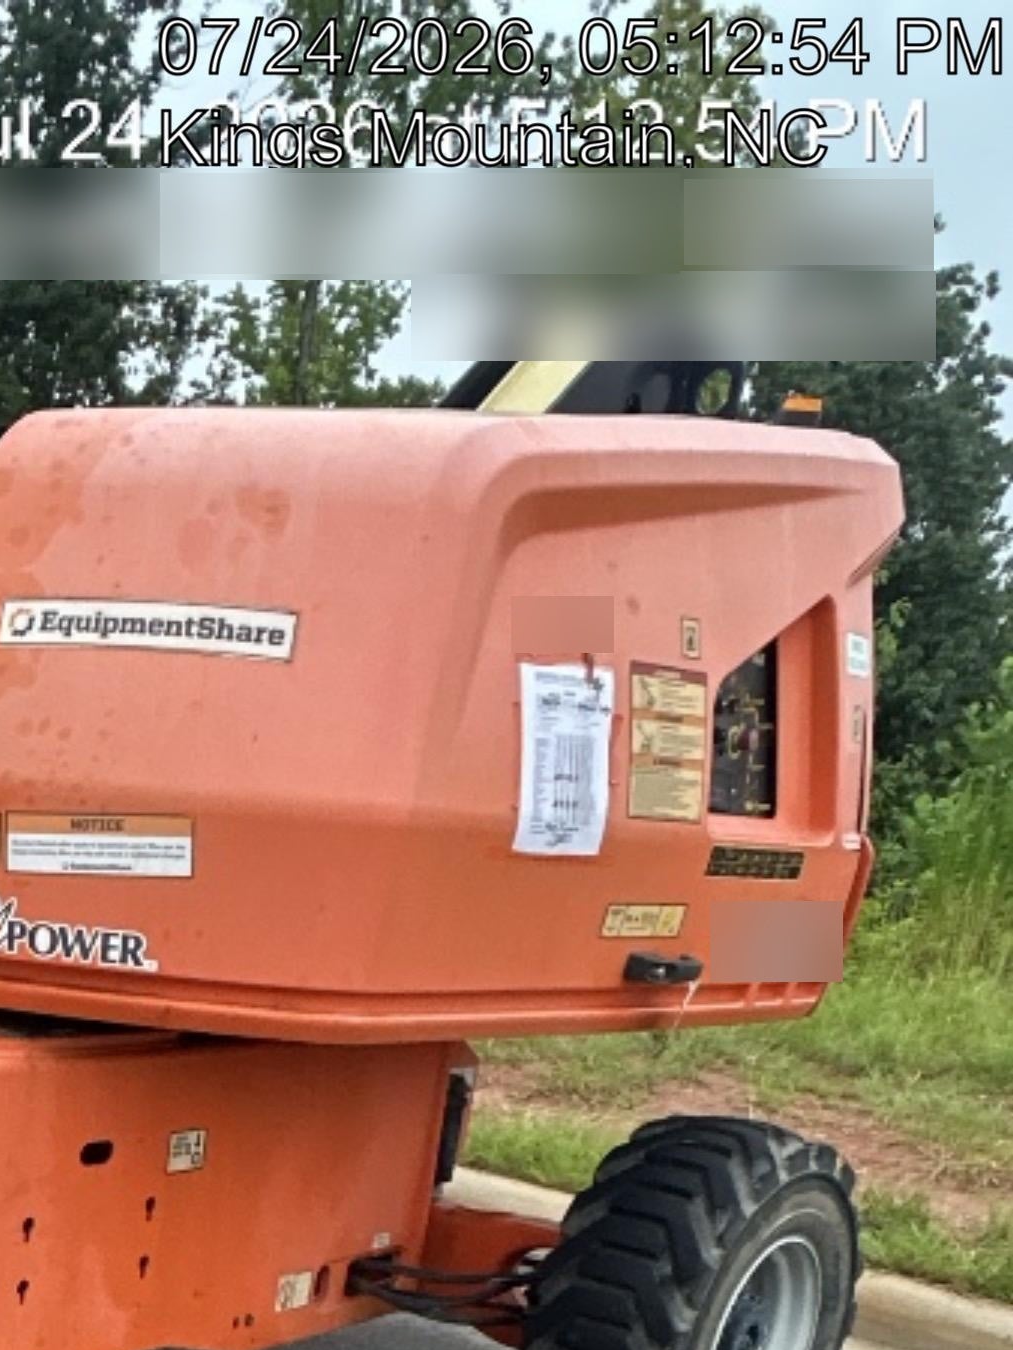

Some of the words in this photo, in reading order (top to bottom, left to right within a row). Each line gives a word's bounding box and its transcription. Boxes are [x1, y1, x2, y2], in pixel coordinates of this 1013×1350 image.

[39, 610, 287, 647] EquipmentShare
[70, 817, 125, 833] NOTICE
[5, 920, 146, 968] POWER
